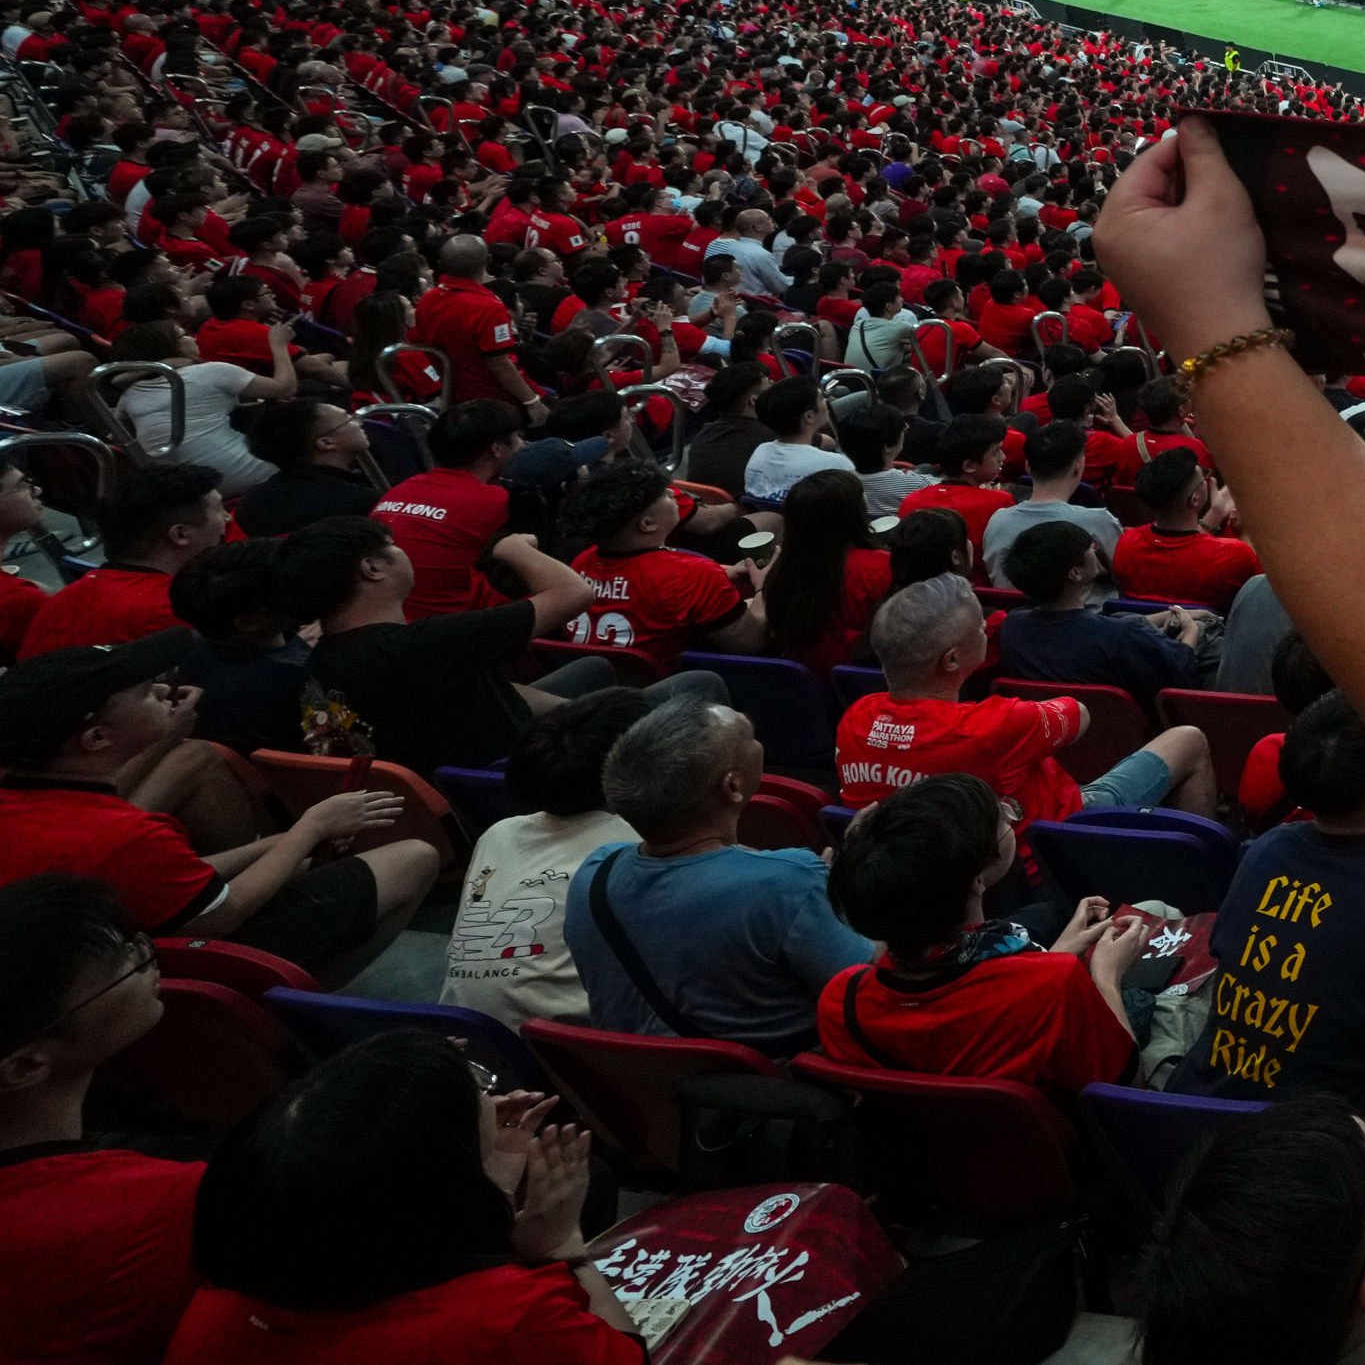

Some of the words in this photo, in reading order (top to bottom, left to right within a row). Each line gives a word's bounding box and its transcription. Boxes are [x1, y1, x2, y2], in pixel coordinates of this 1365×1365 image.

[867, 738, 888, 749] 2025
[869, 731, 914, 744] MARATHON
[871, 720, 916, 735] PATTAYA
[841, 762, 882, 785] HONG
[1255, 875, 1333, 929] Life
[1240, 924, 1279, 973] is
[1280, 941, 1308, 983] a
[1216, 972, 1320, 1054] Crazy
[1209, 1026, 1282, 1090] Ride
